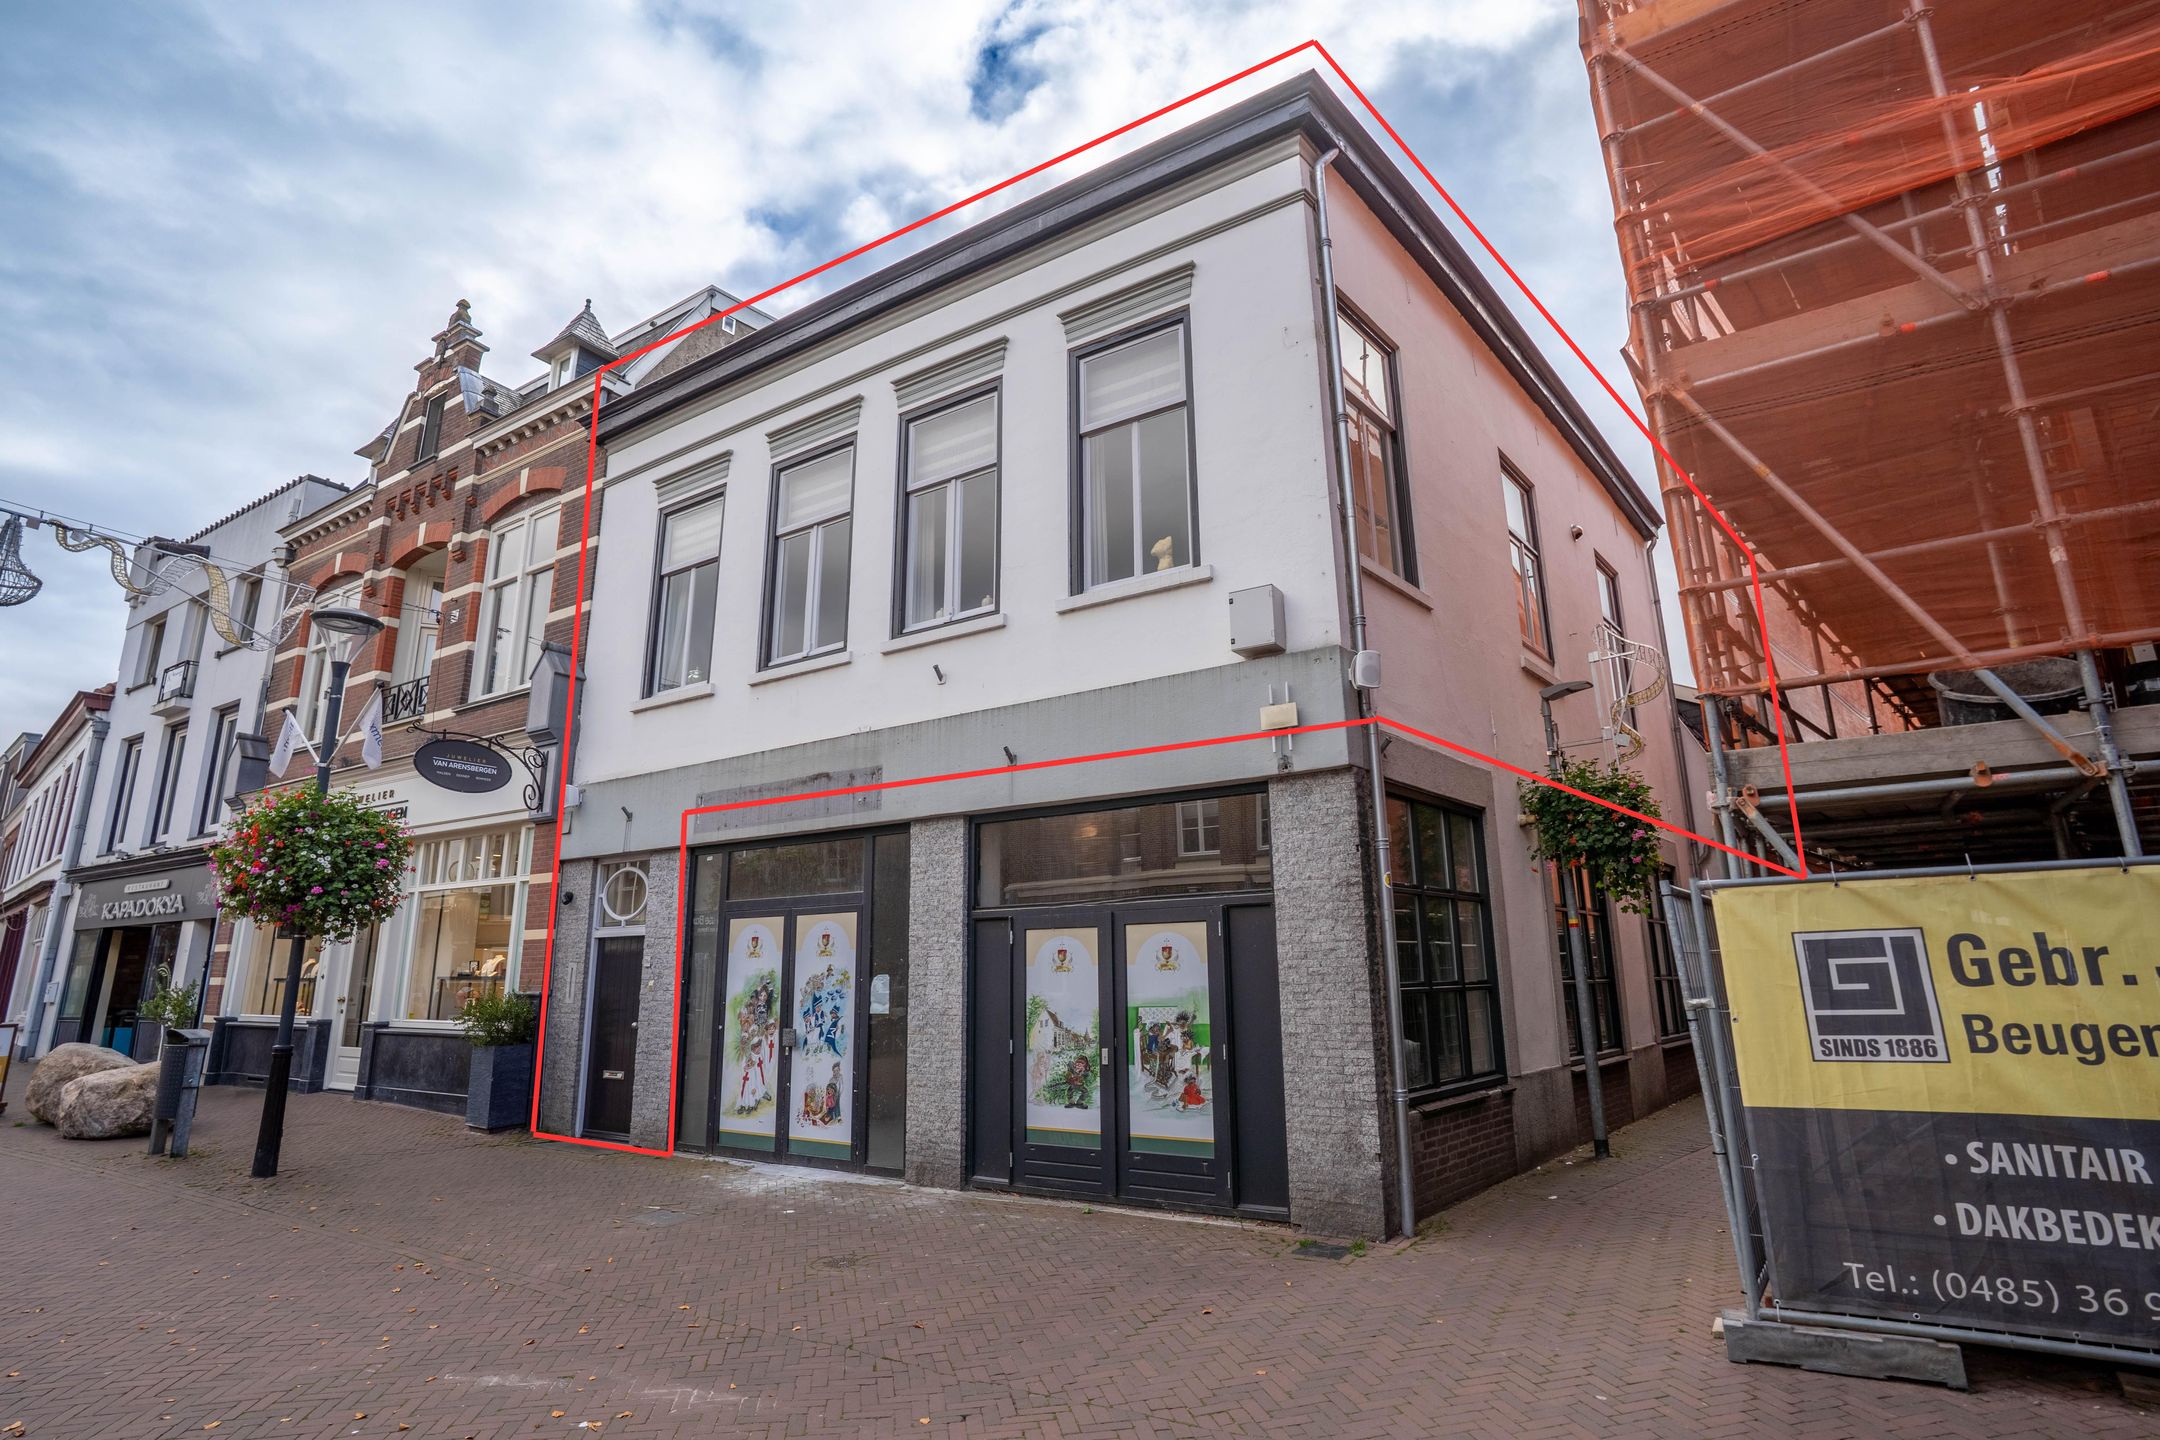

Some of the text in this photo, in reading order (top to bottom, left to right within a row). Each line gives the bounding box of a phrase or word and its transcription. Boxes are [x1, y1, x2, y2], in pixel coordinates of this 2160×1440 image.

[433, 759, 497, 775] VAN ARENSBERGEN
[101, 893, 184, 920] KAPADOKYA
[1946, 931, 2139, 987] Gebr.
[1819, 1038, 1938, 1058] SINDS 1886
[1966, 1141, 2153, 1185] SANITAIR
[1843, 1262, 1919, 1295] Tel.:
[1932, 1269, 2059, 1314] (0485)
[2075, 1284, 2129, 1317] 36
